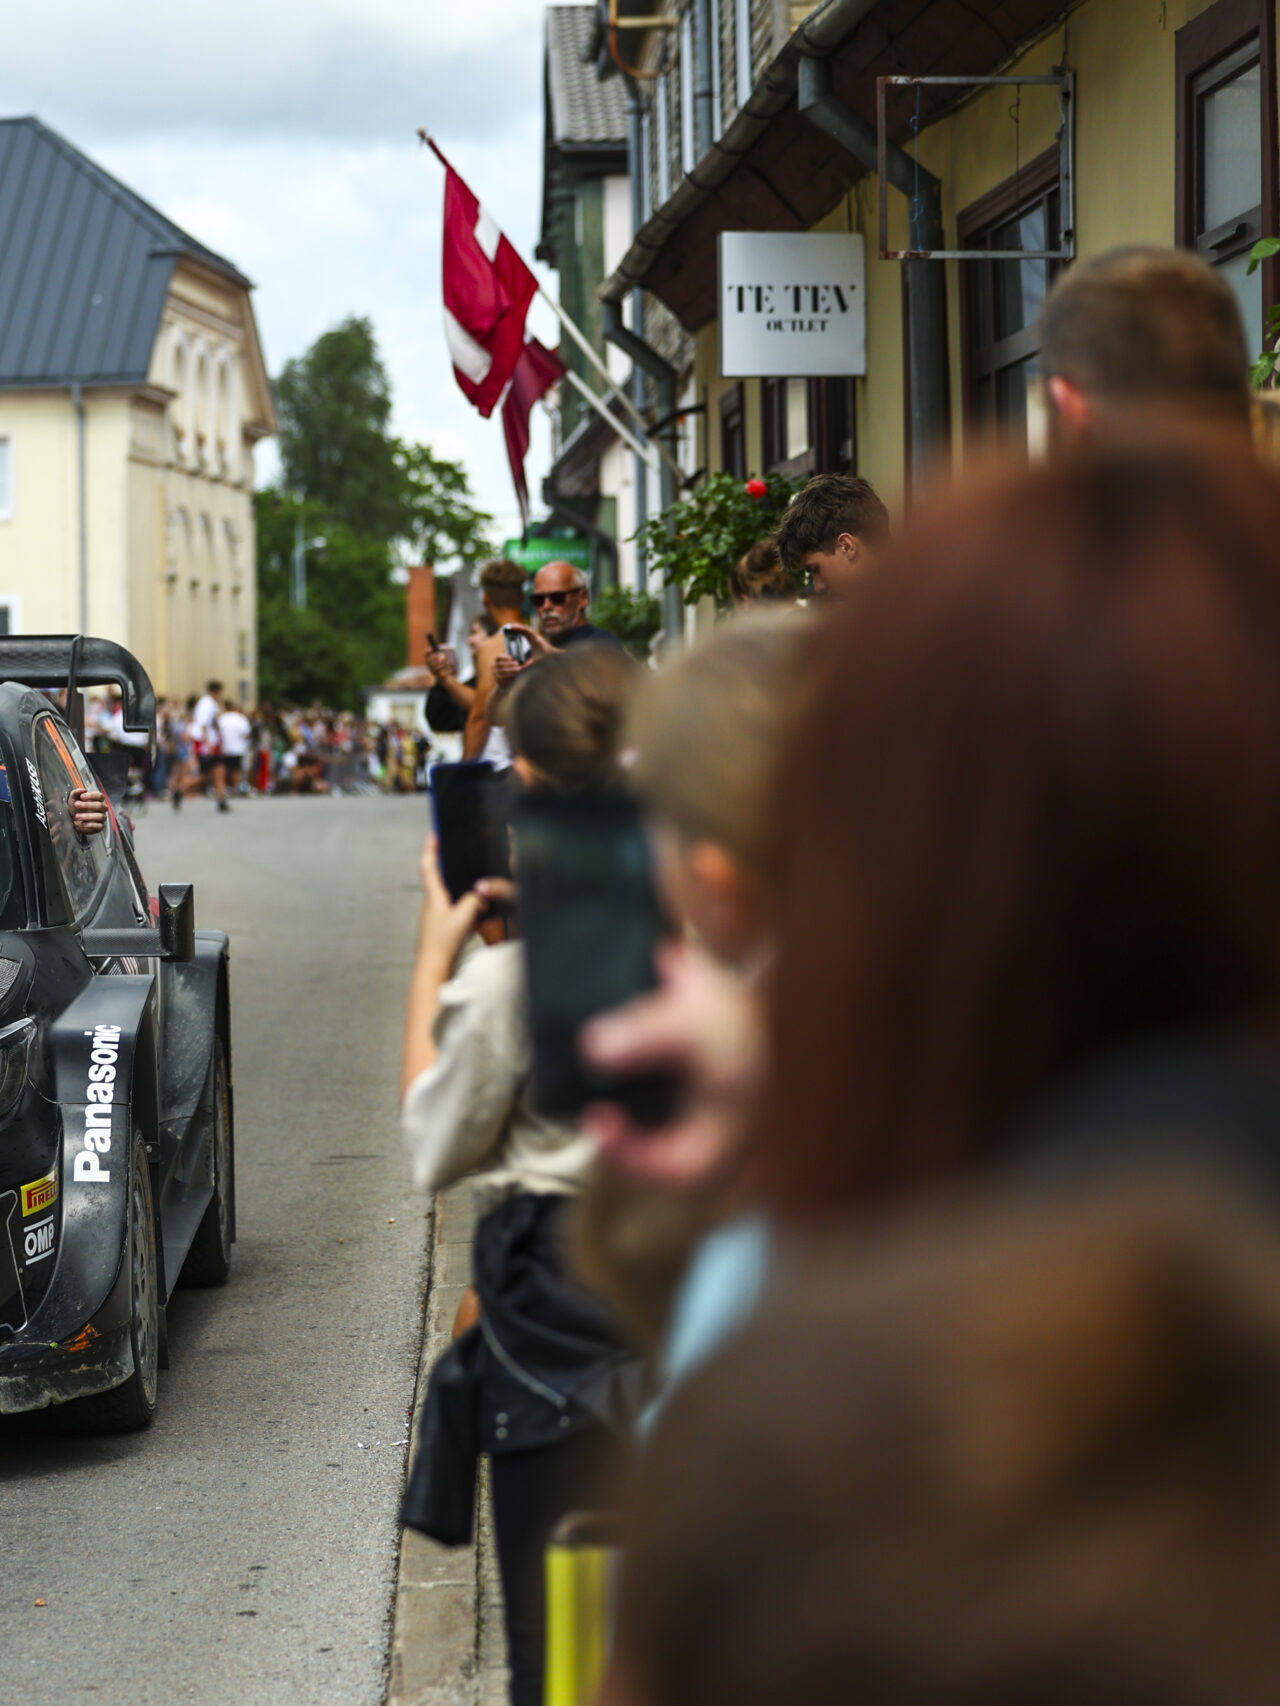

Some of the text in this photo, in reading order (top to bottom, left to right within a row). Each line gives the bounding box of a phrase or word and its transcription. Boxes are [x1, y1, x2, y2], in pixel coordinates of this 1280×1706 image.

[728, 284, 775, 315] TE
[766, 318, 828, 332] OUTLET
[73, 1024, 122, 1183] Panasonic
[24, 1222, 55, 1257] OMP
